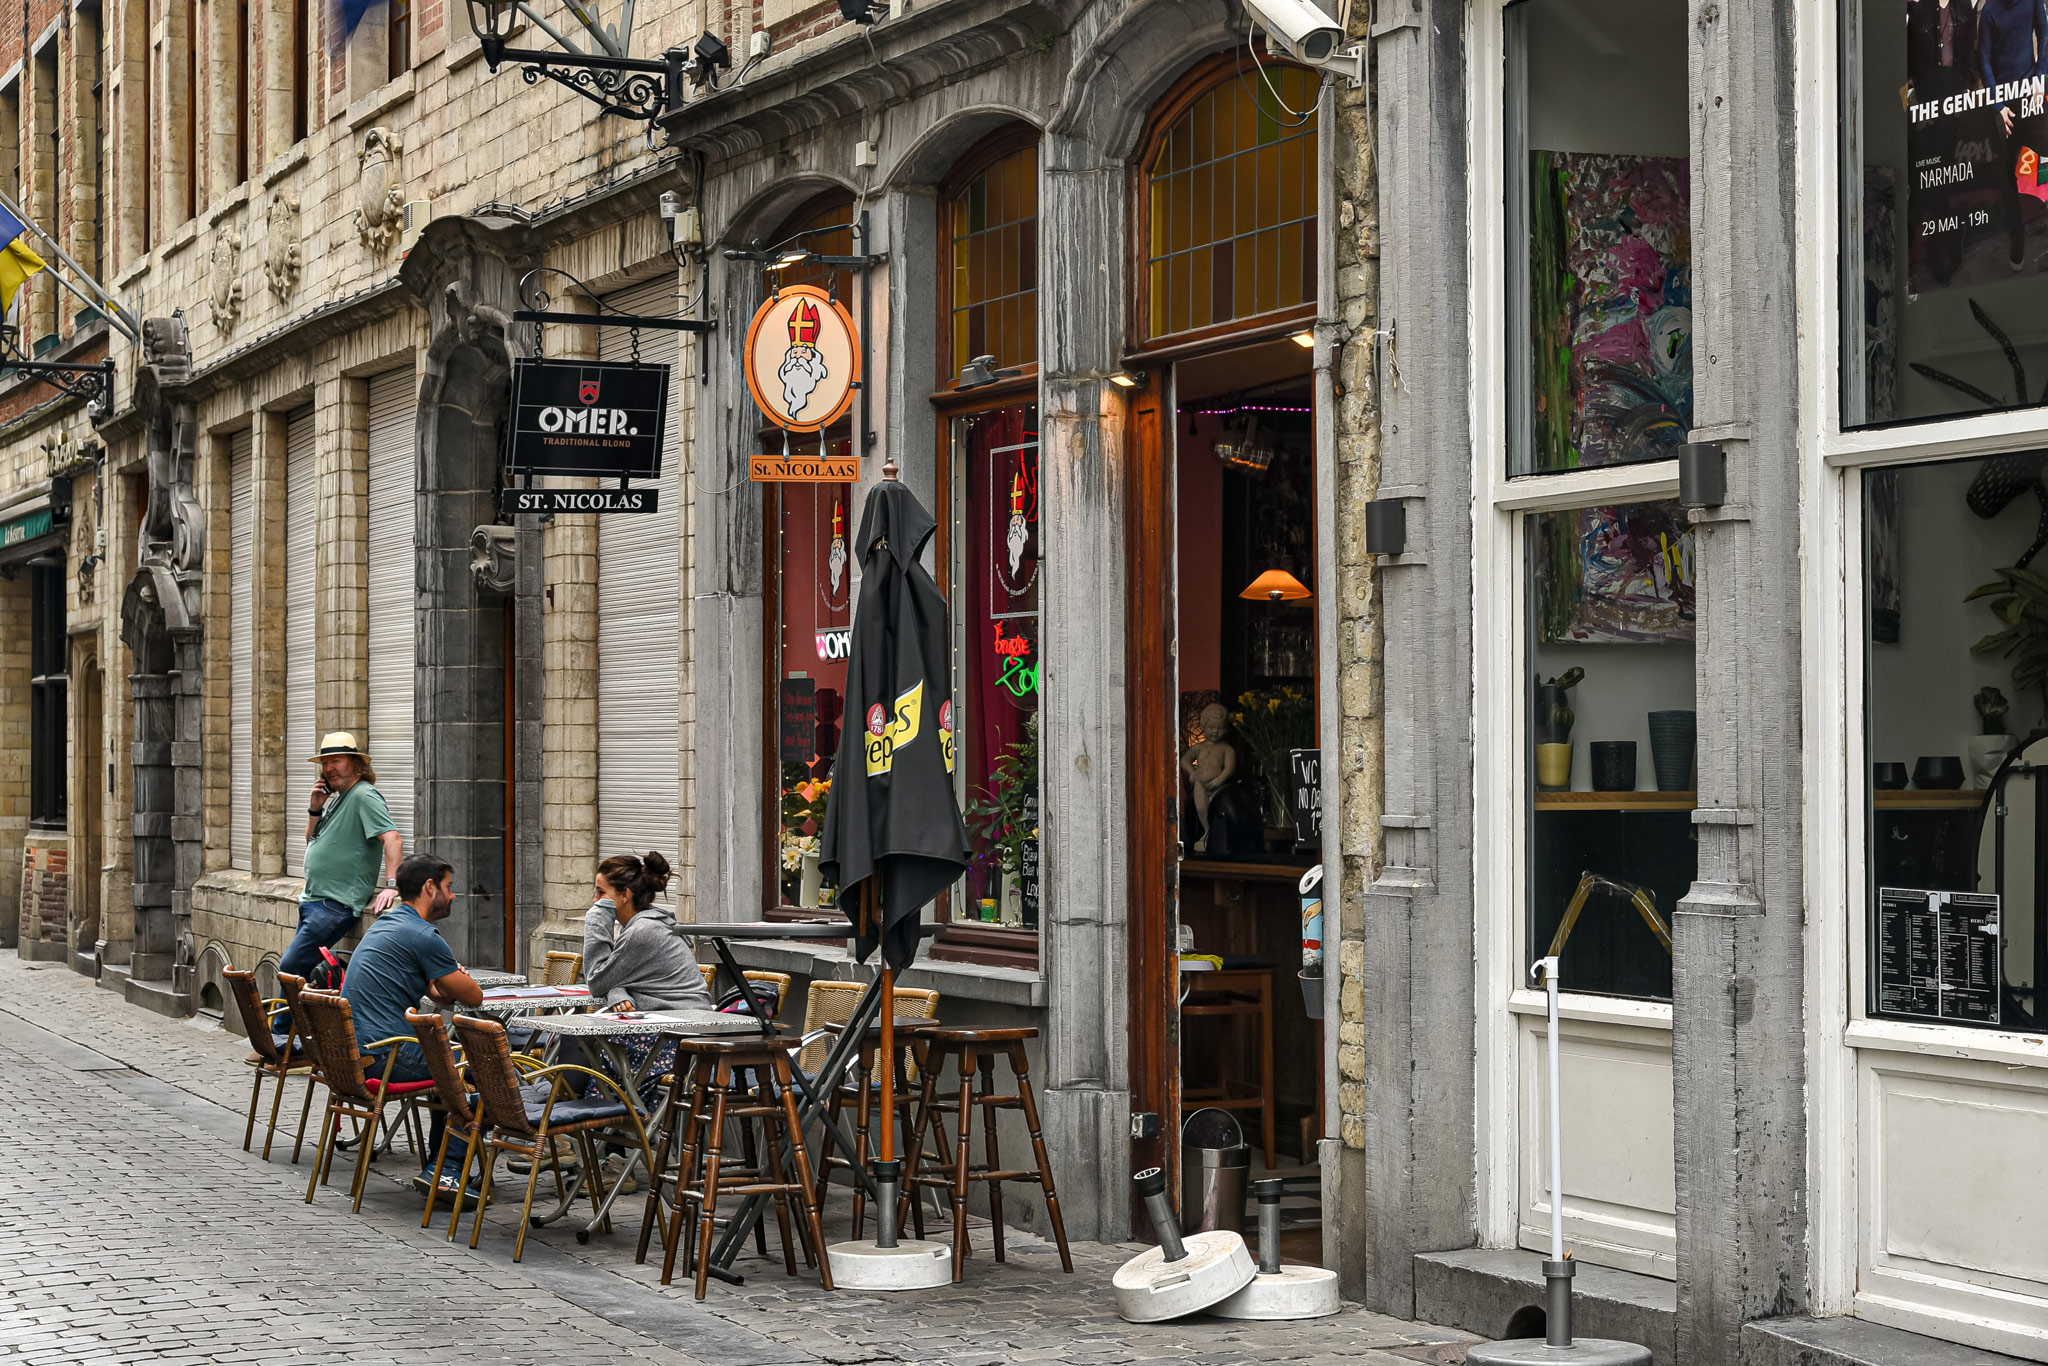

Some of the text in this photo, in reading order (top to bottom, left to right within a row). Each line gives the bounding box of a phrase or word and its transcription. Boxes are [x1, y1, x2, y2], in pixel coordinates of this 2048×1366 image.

[1910, 74, 2045, 123] THE GENTLEMAN
[2021, 94, 2044, 119] BAR
[1915, 156, 1942, 168] LIVE MUSIC
[1920, 161, 1974, 189] NARMADA
[1922, 220, 1936, 236] 29
[1938, 216, 1959, 232] MAI
[1968, 210, 1989, 227] 19h
[538, 406, 638, 436] OMER.
[543, 437, 631, 448] TRADITIONAL BLOND
[754, 463, 855, 476] St. NICOLAAS
[518, 494, 643, 509] ST. NICOLAS
[826, 633, 851, 659] OM
[1301, 759, 1318, 784] WC
[1298, 787, 1309, 809] NO
